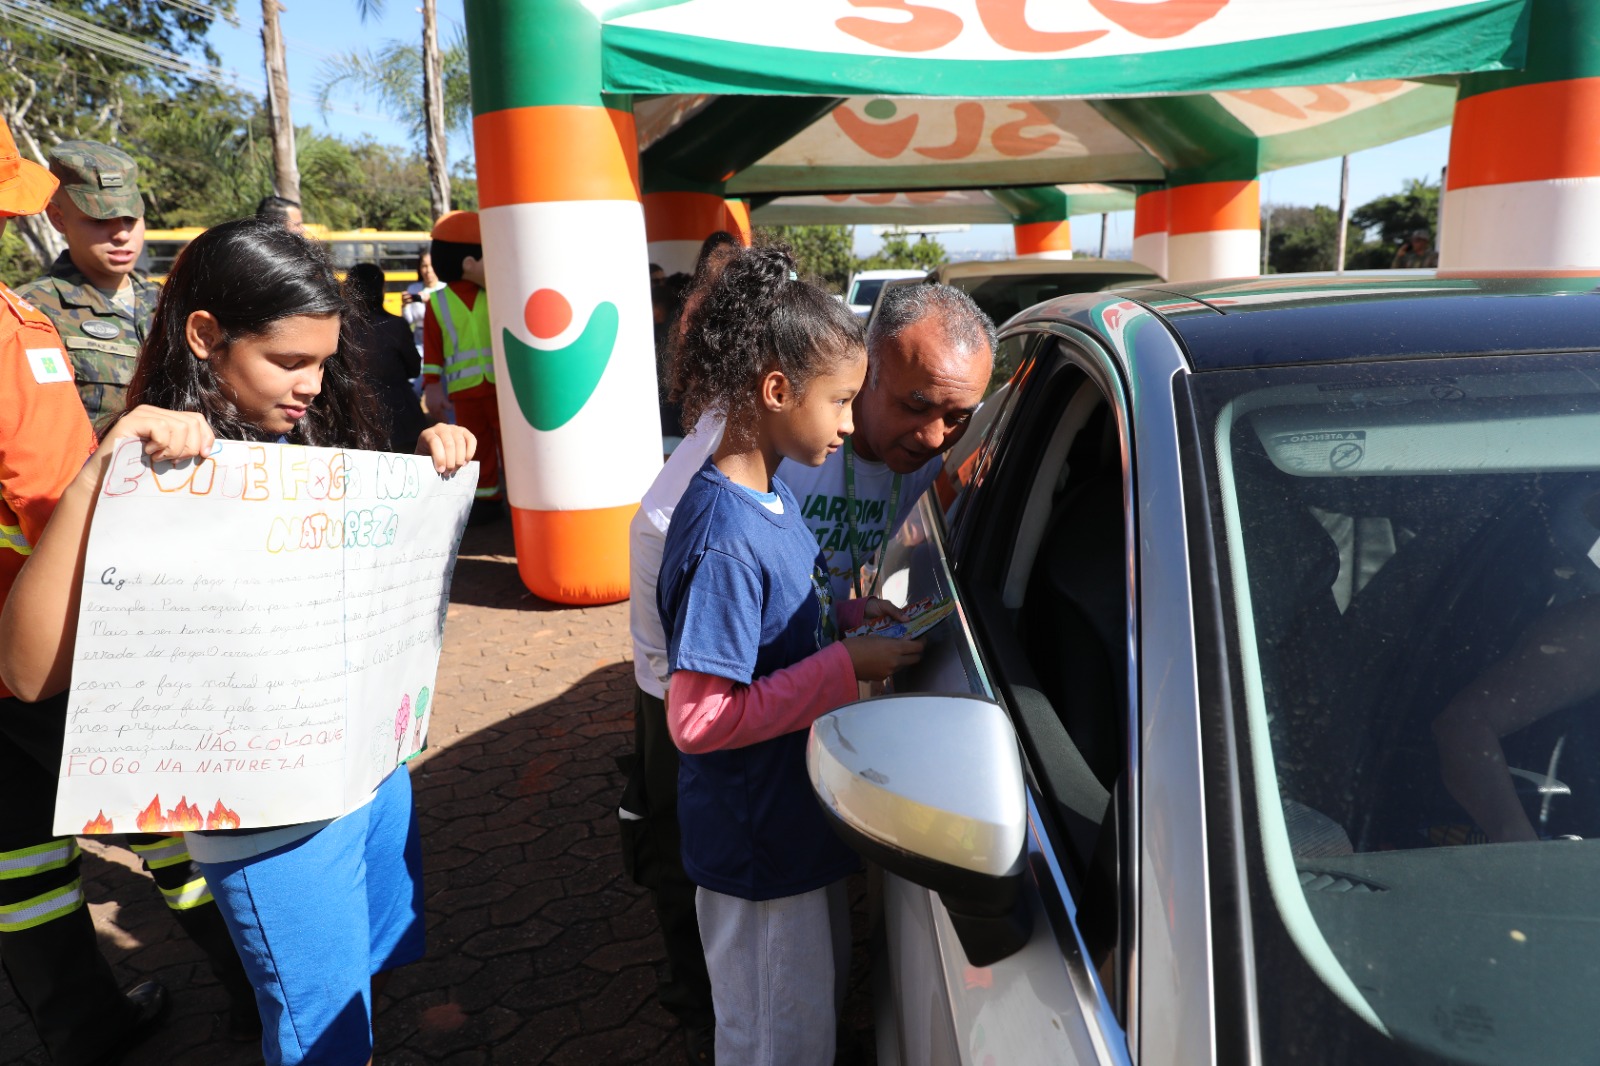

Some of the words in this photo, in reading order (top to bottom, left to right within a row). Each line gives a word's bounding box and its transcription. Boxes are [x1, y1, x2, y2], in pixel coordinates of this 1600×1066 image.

[280, 446, 362, 501] FOGO
[376, 456, 420, 500] NA
[801, 494, 885, 525] JARDIM
[266, 504, 399, 554] NATUREZA
[89, 619, 129, 638] Mais
[151, 628, 173, 637] ser
[179, 623, 233, 636] humano
[83, 646, 138, 661] errado
[144, 644, 166, 658] do
[220, 645, 271, 659] cerrado
[77, 680, 122, 692] com
[134, 680, 146, 688] o
[156, 673, 193, 699] fogo
[201, 671, 259, 690] natural
[265, 679, 285, 695] que
[75, 700, 90, 721] já
[104, 701, 123, 713] o
[129, 695, 174, 719] fogo
[181, 694, 217, 717] feito
[223, 696, 258, 719] pelo
[76, 721, 109, 734] nos
[114, 720, 199, 739] prejudica
[226, 714, 251, 732] tira
[195, 729, 237, 752] NÃO
[247, 728, 344, 751] COLOQUE
[68, 754, 141, 778] FOGO
[155, 758, 183, 774] NA
[196, 754, 306, 774] NATUREZA
